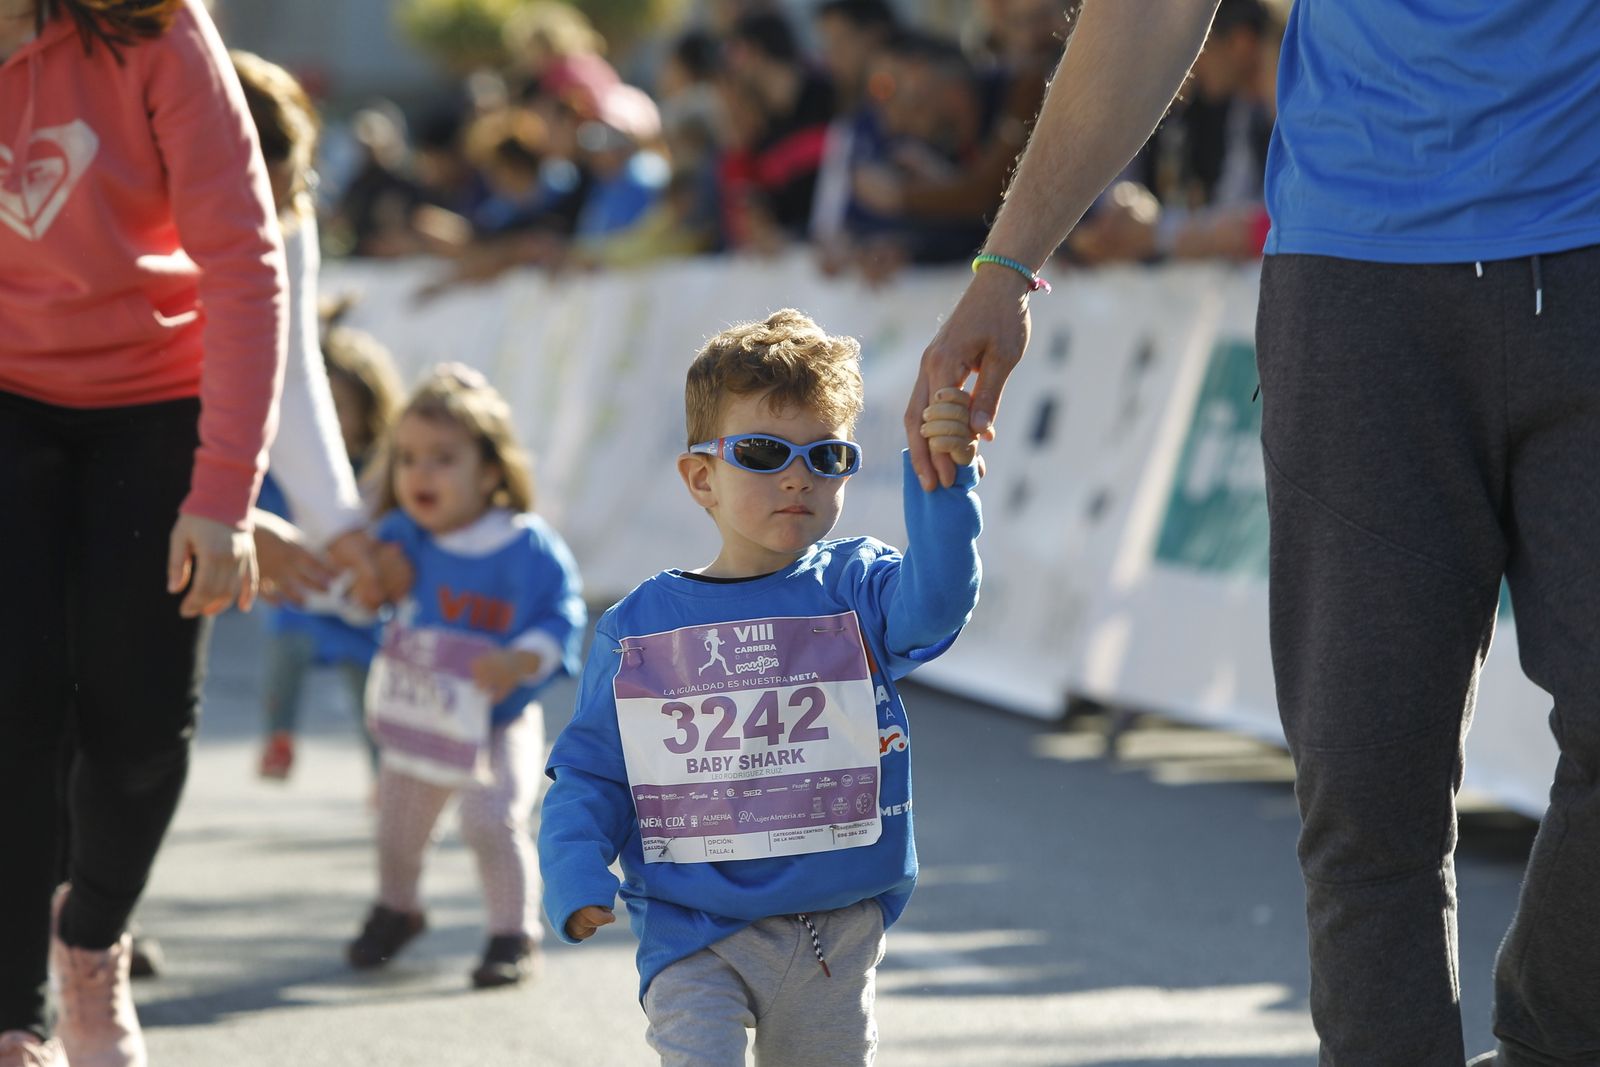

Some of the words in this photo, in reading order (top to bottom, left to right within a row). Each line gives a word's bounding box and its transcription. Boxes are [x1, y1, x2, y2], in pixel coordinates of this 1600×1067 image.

[733, 624, 774, 643] VIII
[734, 643, 777, 654] CARRERA
[735, 653, 752, 661] DE
[663, 688, 676, 696] LA
[676, 681, 725, 695] IGUALDAD
[727, 679, 740, 688] ES
[741, 675, 789, 687] NUESTRA
[789, 671, 819, 683] META
[661, 686, 830, 755] 3242
[686, 755, 734, 774] BABY
[738, 748, 806, 771] SHARK
[711, 772, 723, 780] LEO
[765, 766, 783, 775] RUIZ
[665, 816, 686, 828] CDX
[703, 813, 732, 822] ALMERÍA
[707, 838, 734, 846] OPCIÓN:
[709, 847, 730, 855] TALLA:
